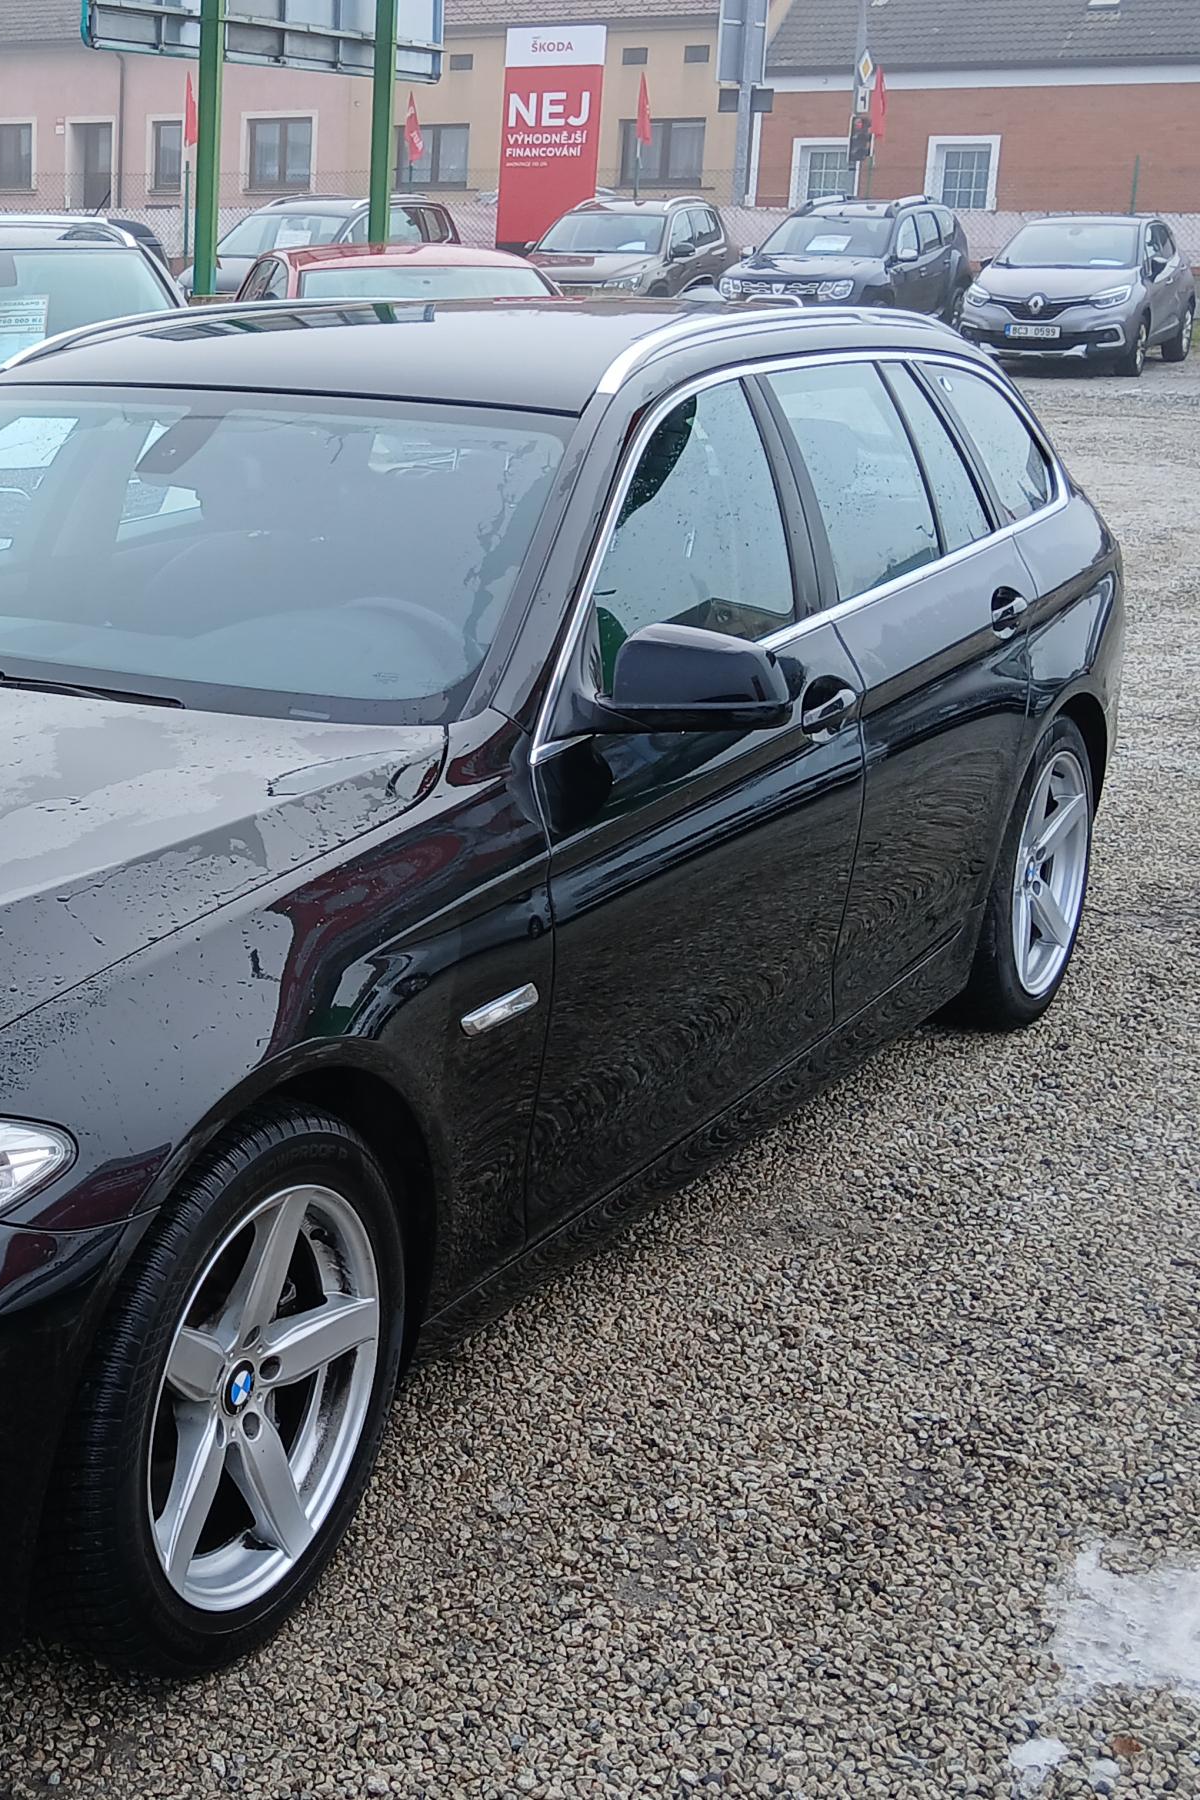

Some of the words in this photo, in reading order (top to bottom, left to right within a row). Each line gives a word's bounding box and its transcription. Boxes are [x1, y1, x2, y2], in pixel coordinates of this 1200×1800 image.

[531, 40, 574, 53] ŠKODA
[508, 91, 591, 128] NEJ
[507, 130, 587, 145] VÝHODNĚJŠÍ
[506, 145, 581, 158] FINANCOVÁNÍ
